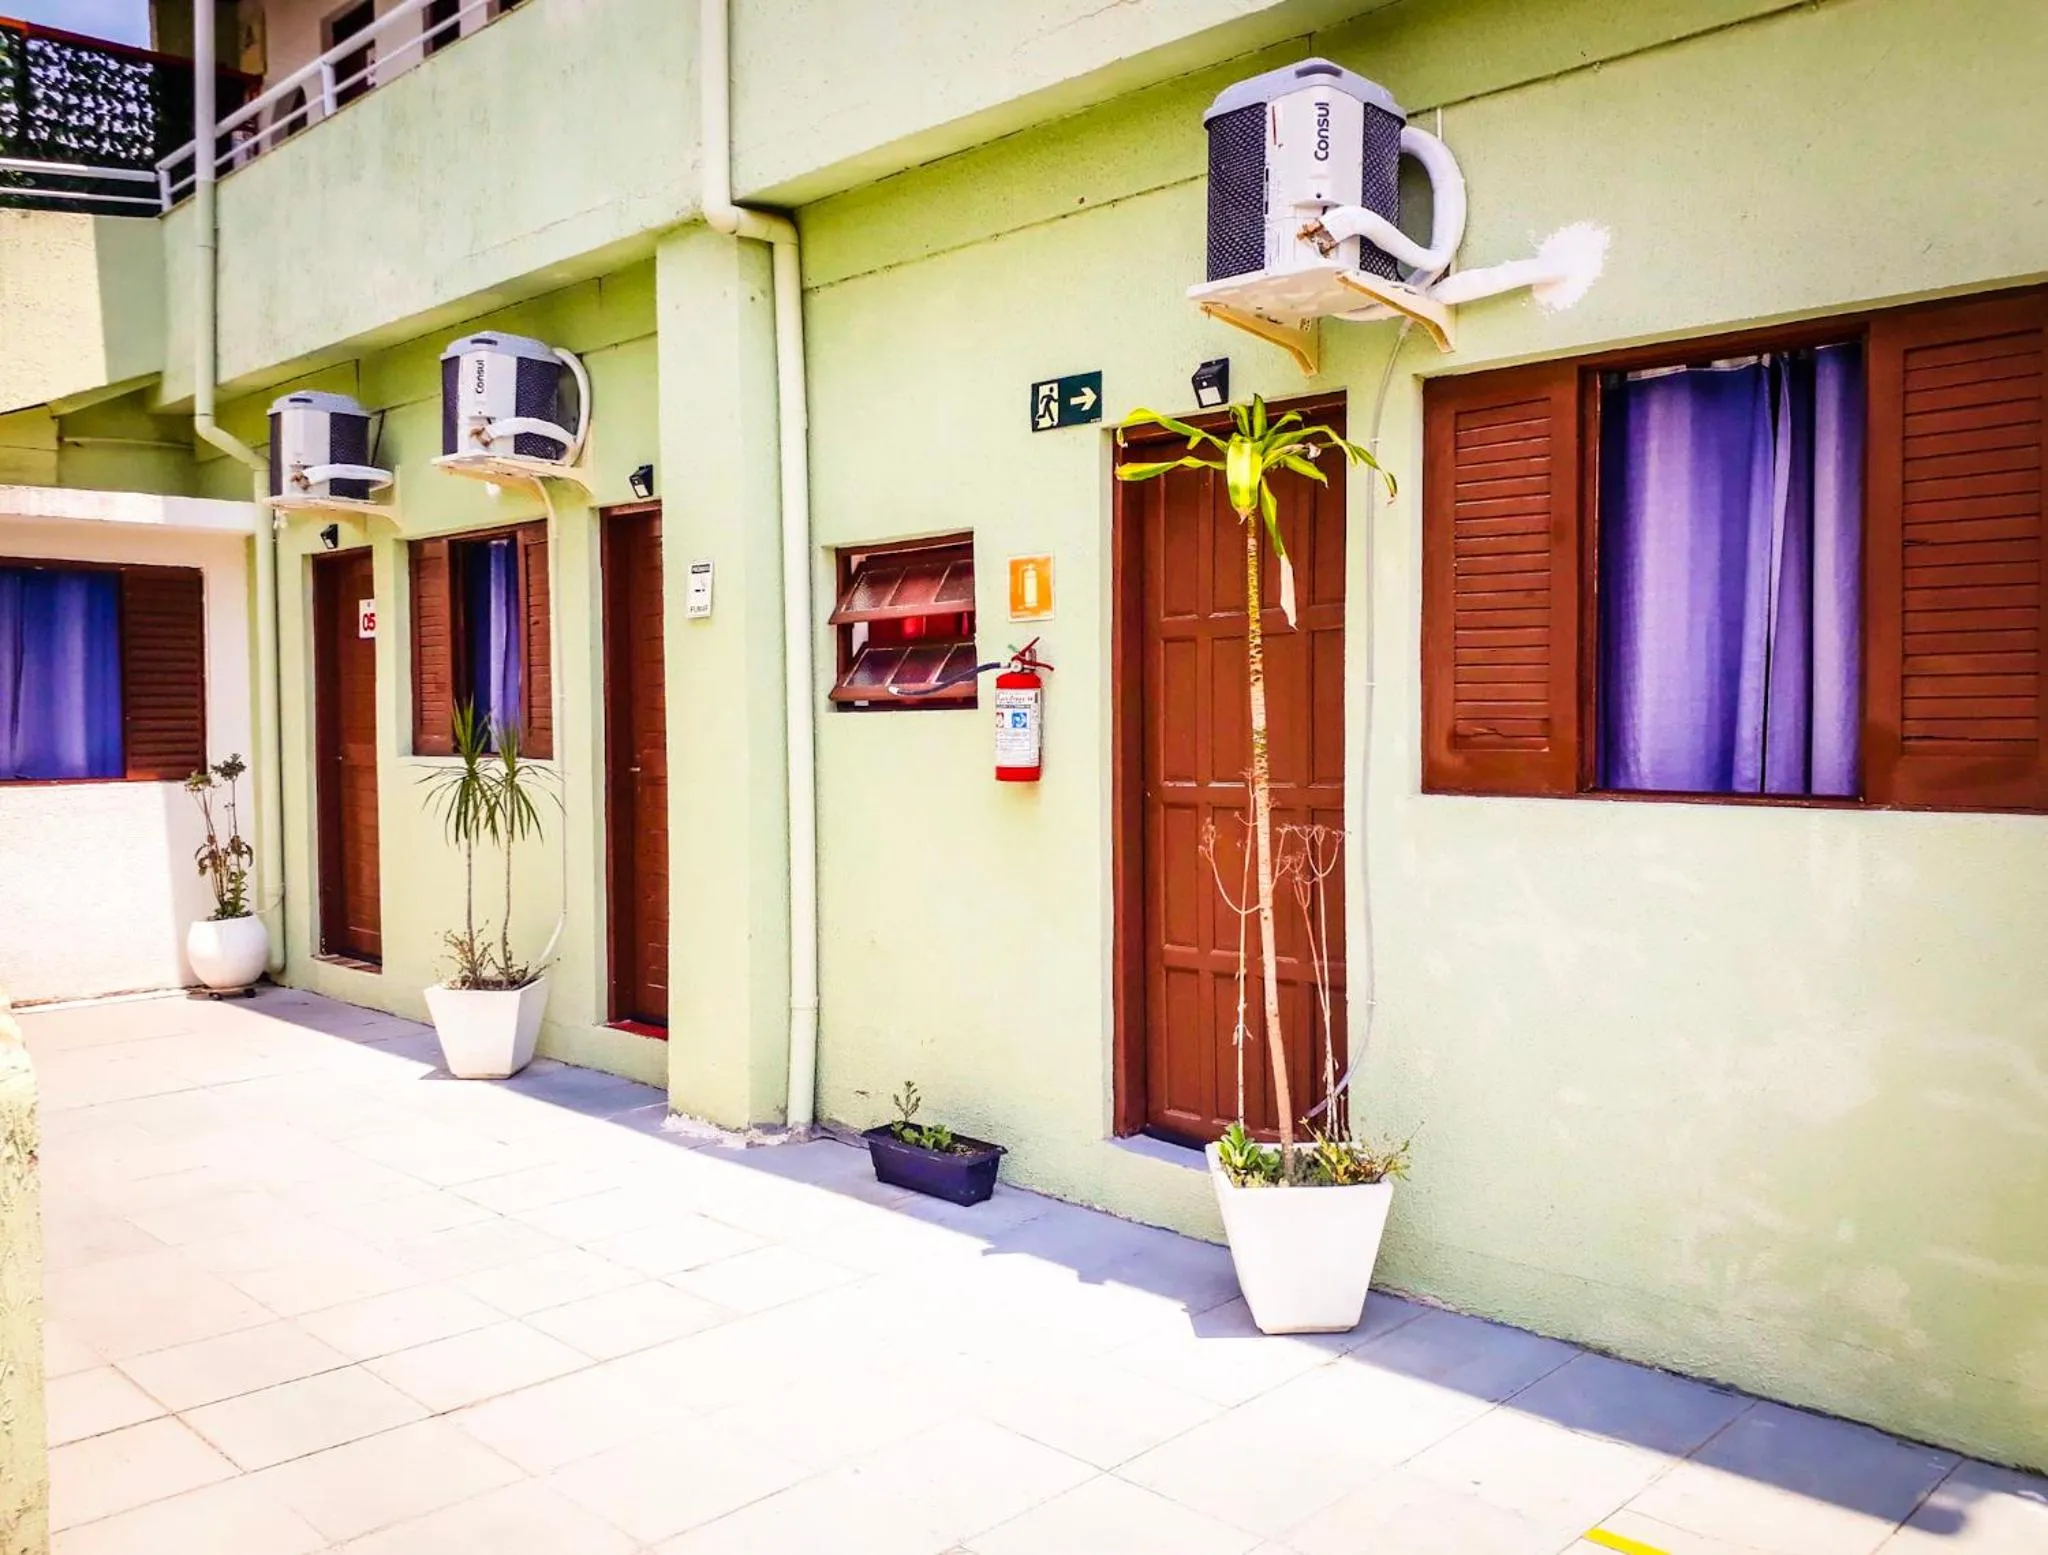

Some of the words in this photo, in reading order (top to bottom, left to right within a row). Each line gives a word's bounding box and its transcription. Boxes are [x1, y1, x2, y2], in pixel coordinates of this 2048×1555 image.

[1314, 102, 1330, 162] Consul
[475, 359, 485, 394] Consul
[362, 612, 376, 632] 05
